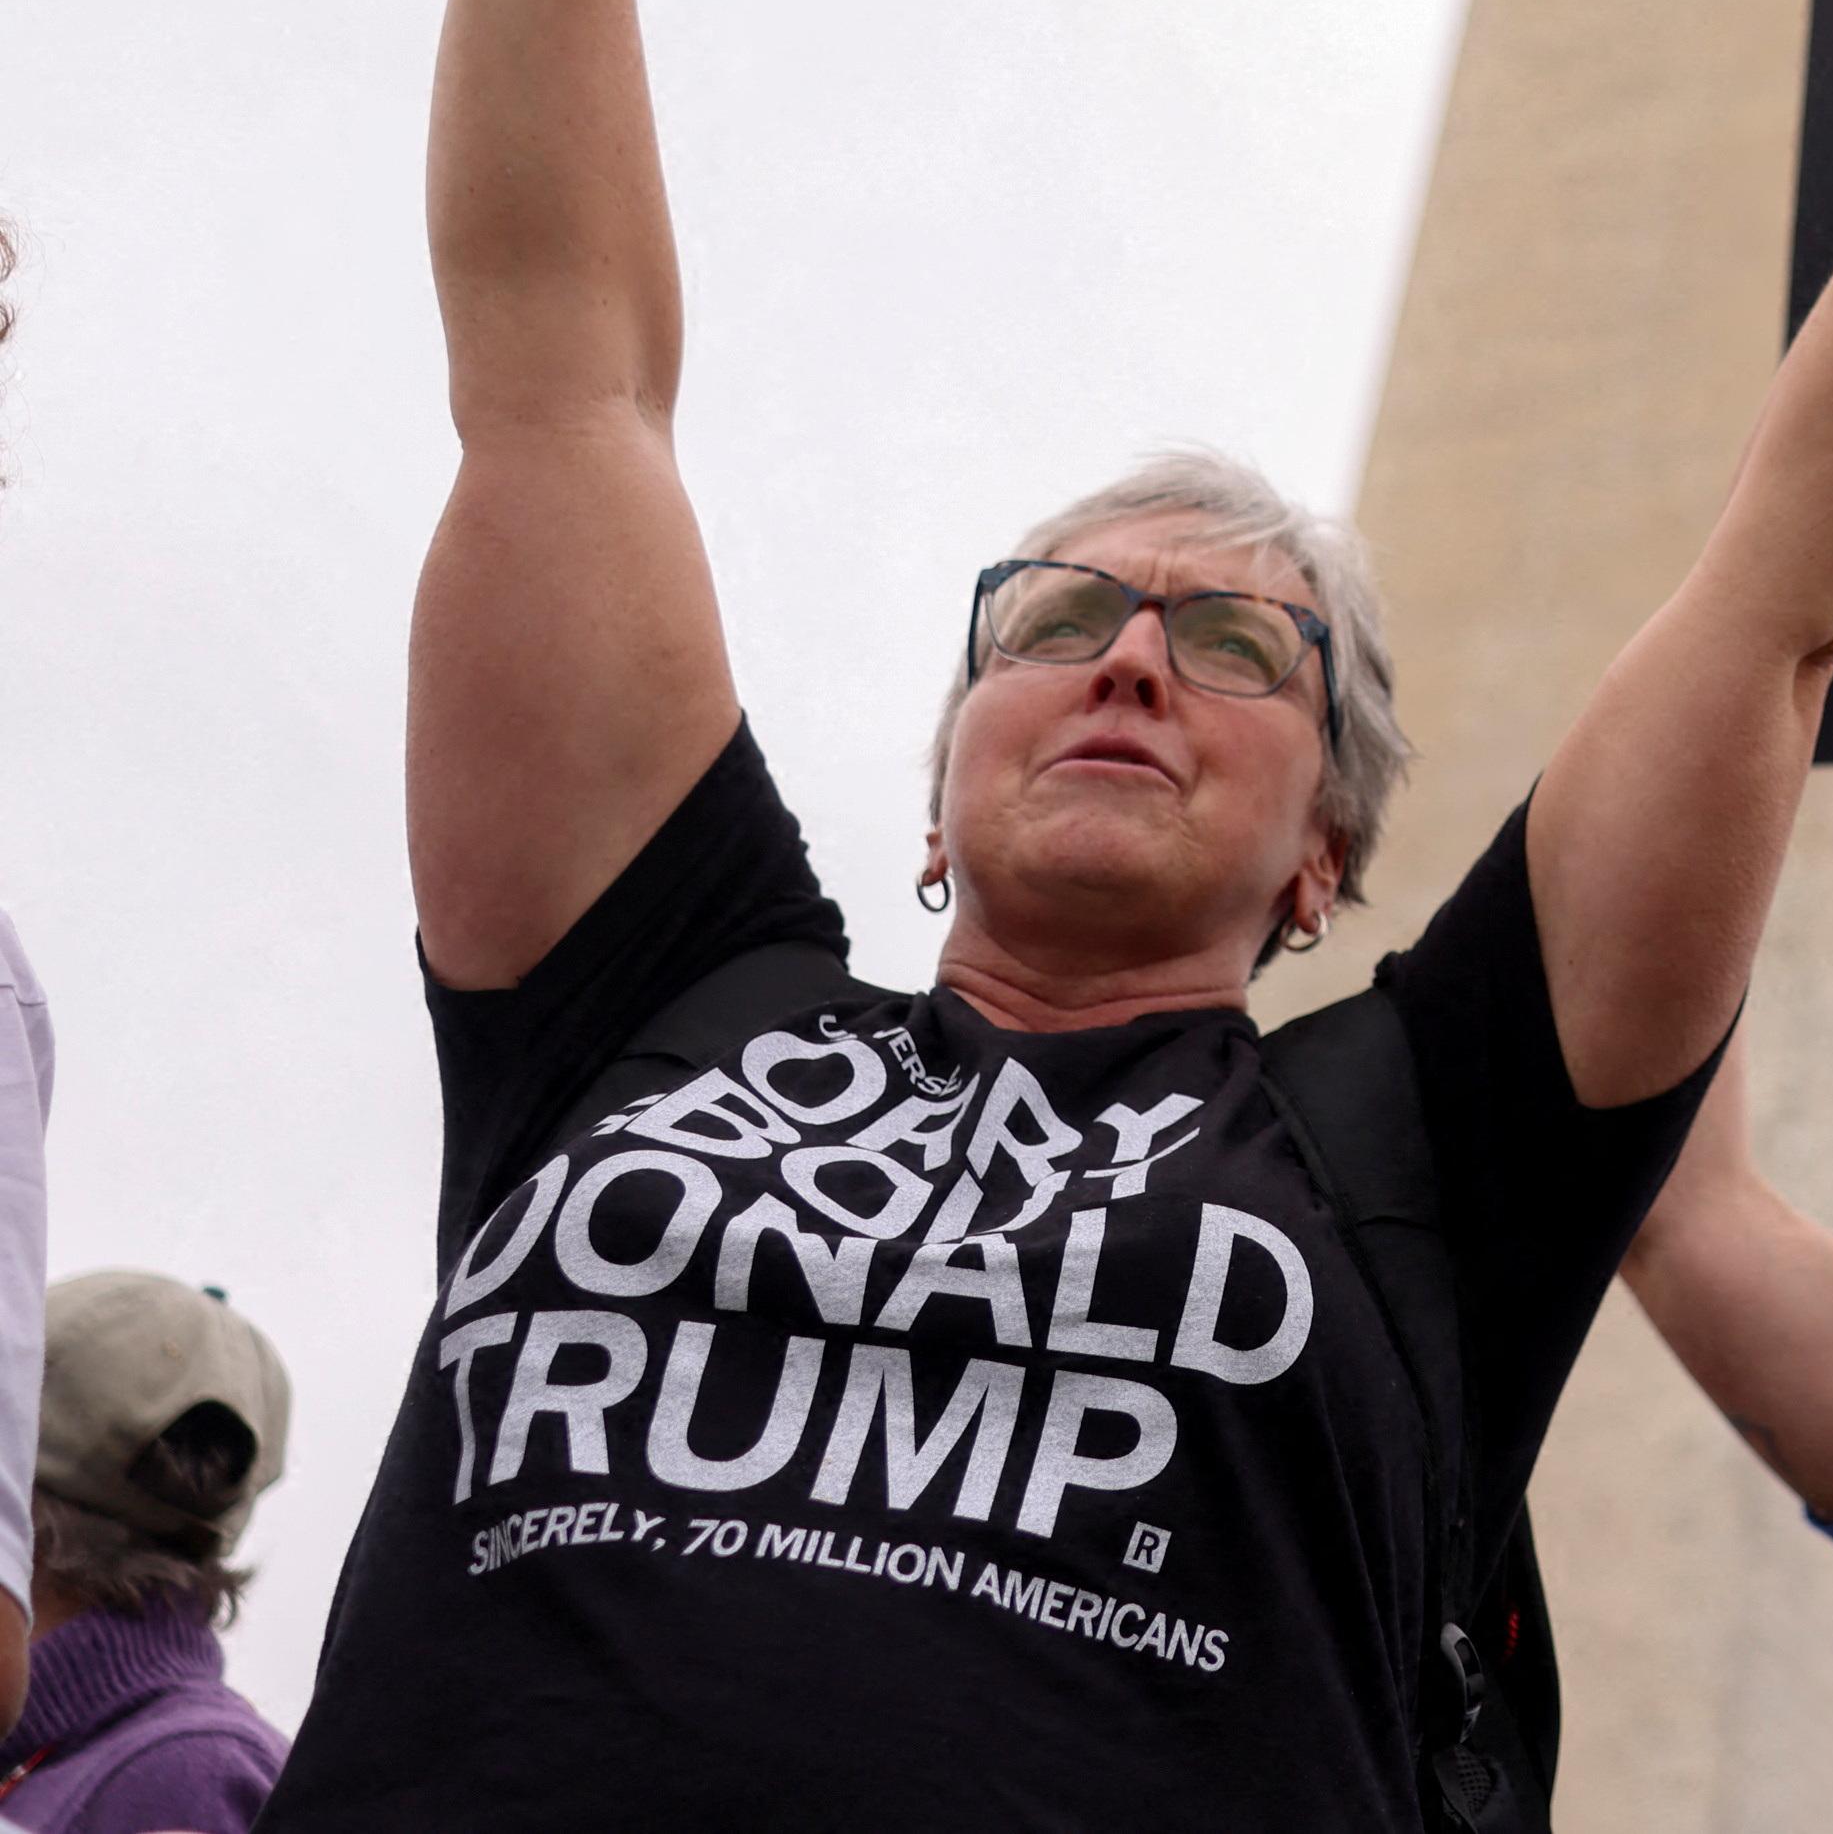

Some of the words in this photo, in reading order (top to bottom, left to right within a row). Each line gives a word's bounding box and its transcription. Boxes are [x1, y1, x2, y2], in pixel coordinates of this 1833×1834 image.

[443, 1147, 1313, 1386] DONALD
[437, 1308, 1179, 1539] TRUMP
[467, 1501, 667, 1576] SINCERELY,
[681, 1518, 749, 1558] 70
[753, 1522, 966, 1592] MILLION
[970, 1561, 1230, 1673] AMERICANS
